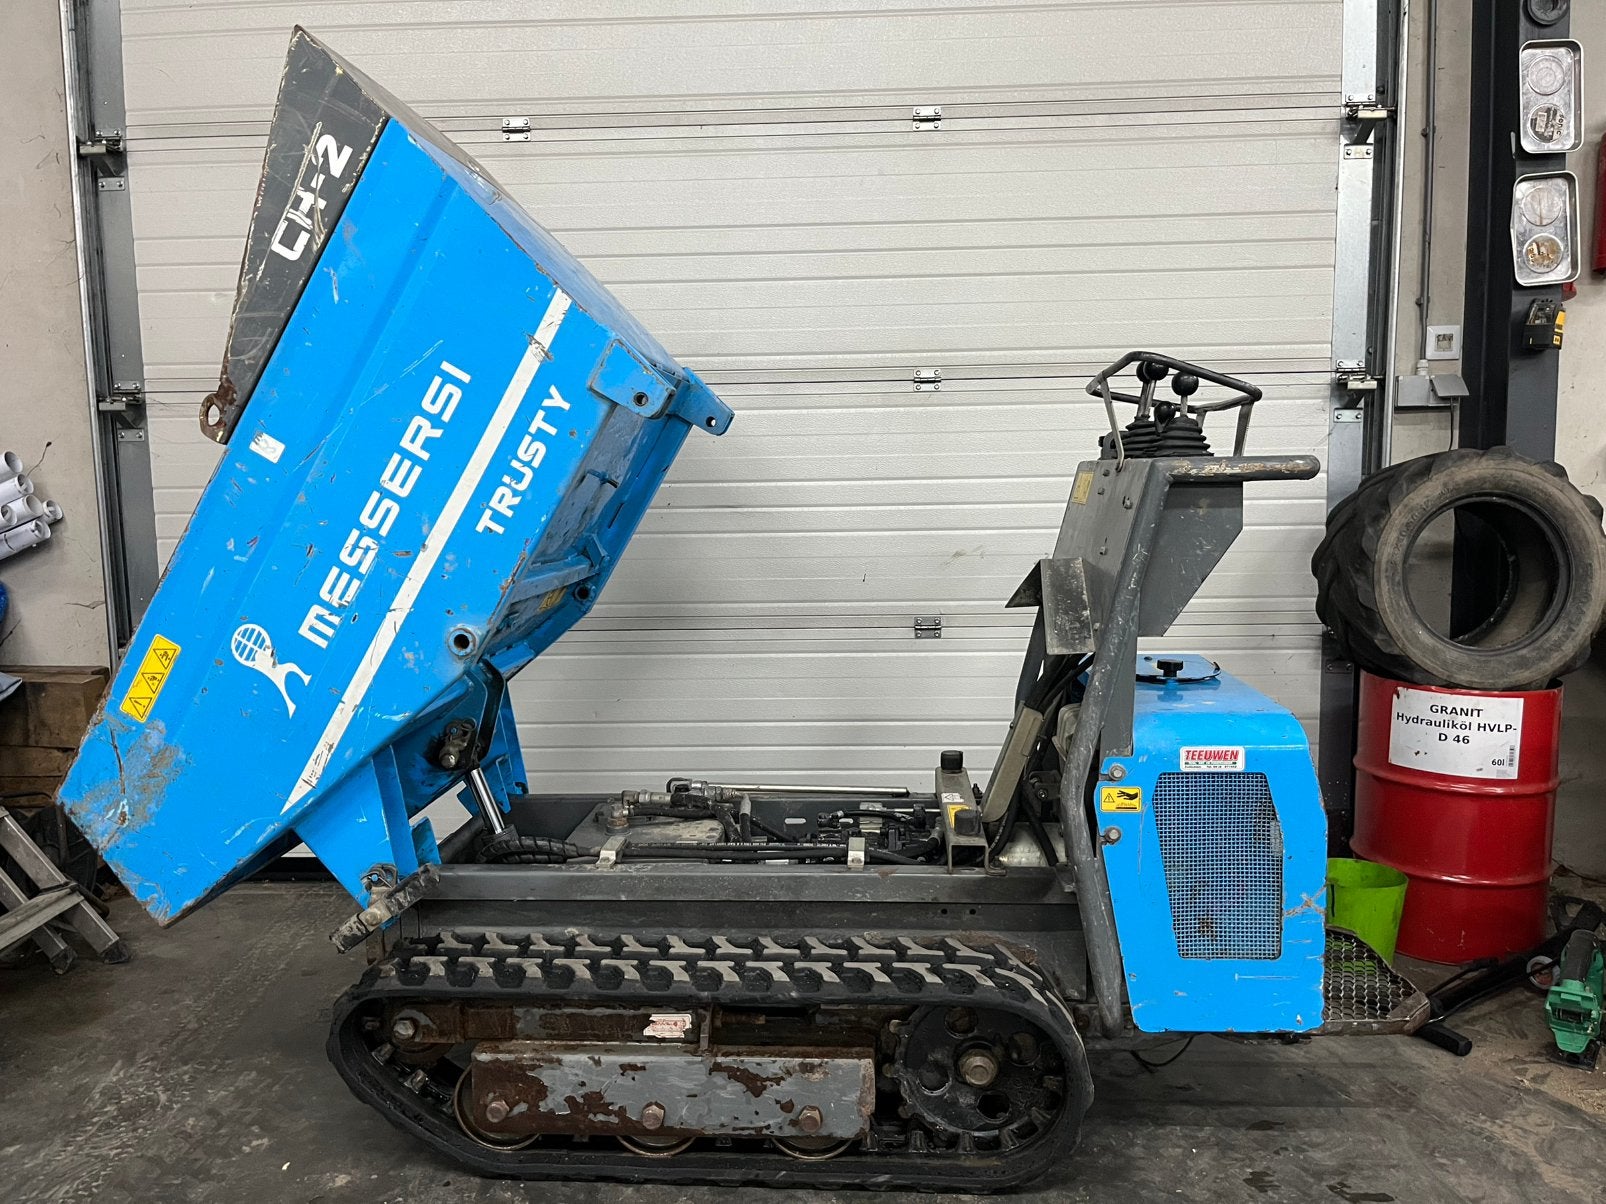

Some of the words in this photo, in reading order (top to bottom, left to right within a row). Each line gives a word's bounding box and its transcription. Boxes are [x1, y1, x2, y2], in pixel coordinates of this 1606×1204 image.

[271, 134, 354, 261] CH-2
[475, 385, 571, 535] TRUSTY
[298, 361, 471, 649] MESSERSI
[1429, 704, 1484, 718] GRANIT
[1396, 712, 1472, 731] Hydrauliköl
[1477, 723, 1518, 733] HVLP-
[1438, 733, 1448, 742] D
[1453, 735, 1470, 745] 46
[1184, 749, 1240, 761] TEEUWEN
